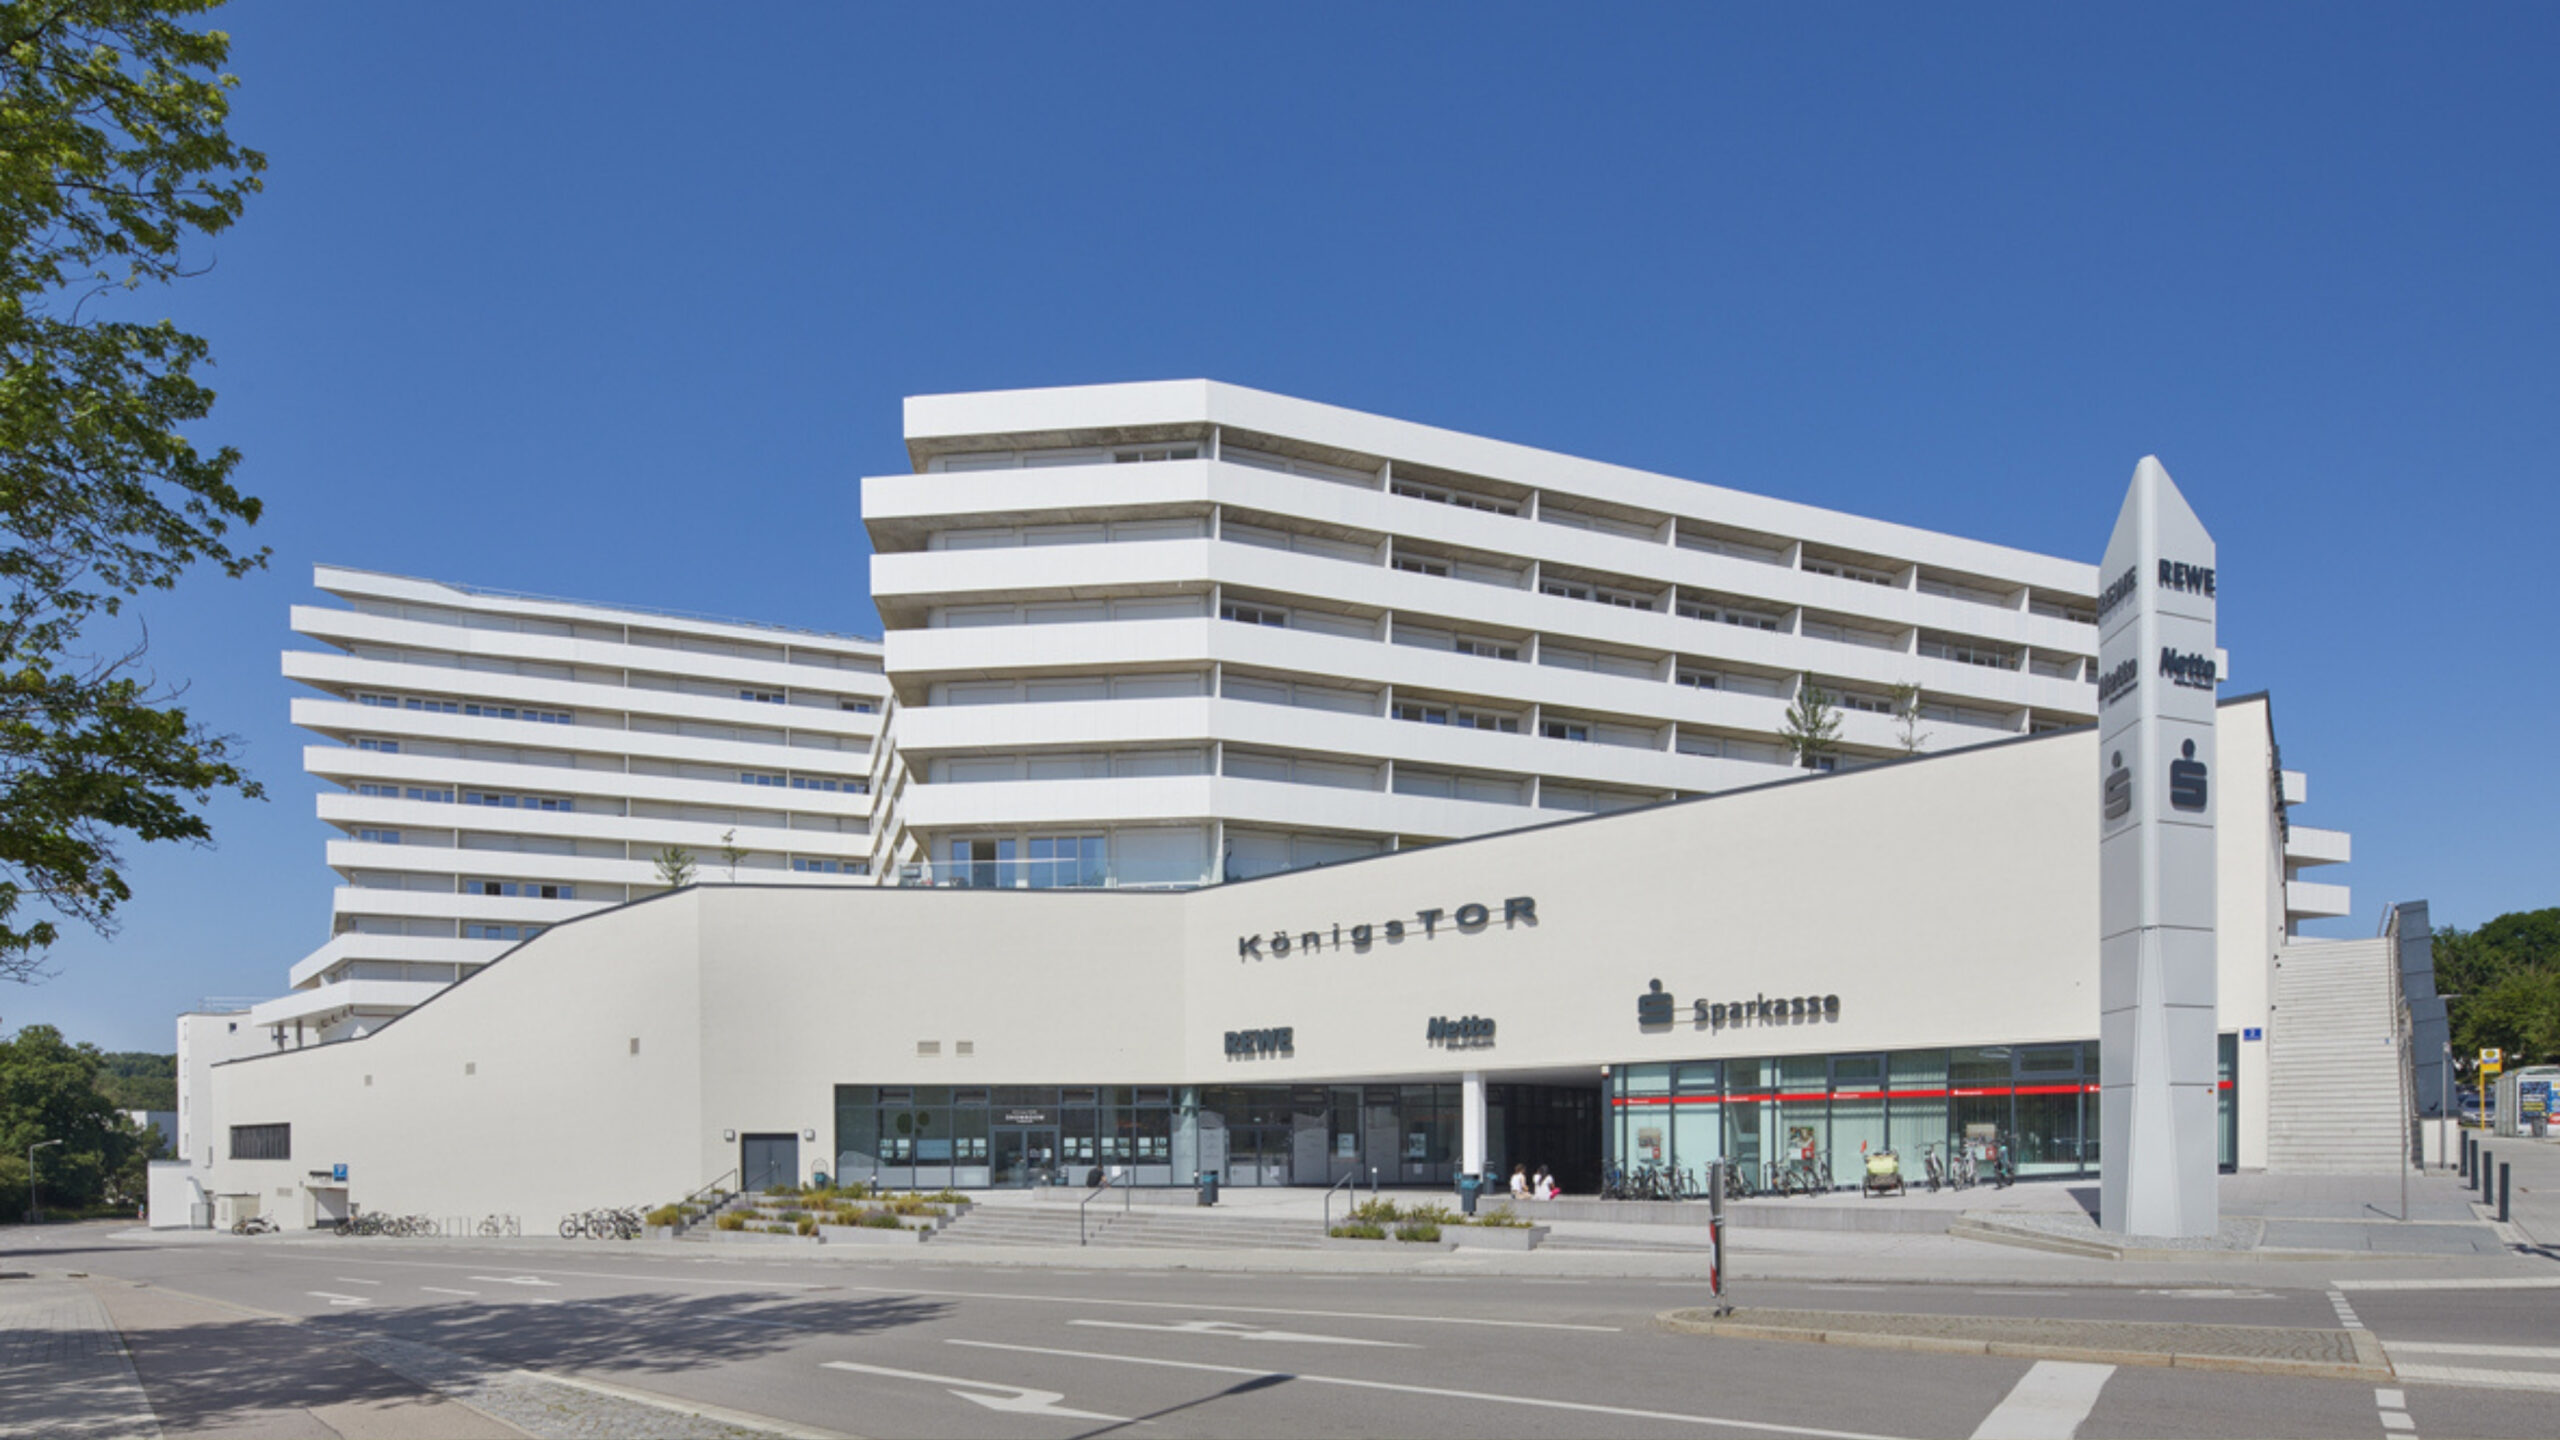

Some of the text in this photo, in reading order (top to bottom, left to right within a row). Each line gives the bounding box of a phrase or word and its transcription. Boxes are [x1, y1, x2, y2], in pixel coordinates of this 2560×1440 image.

[2157, 558, 2216, 596] REWE
[2159, 646, 2216, 681] Netto
[1238, 896, 1538, 961] KönigsTOR
[1426, 1015, 1496, 1040] Netto
[1693, 992, 1839, 1034] Sparkasse
[1224, 1026, 1294, 1056] REWE
